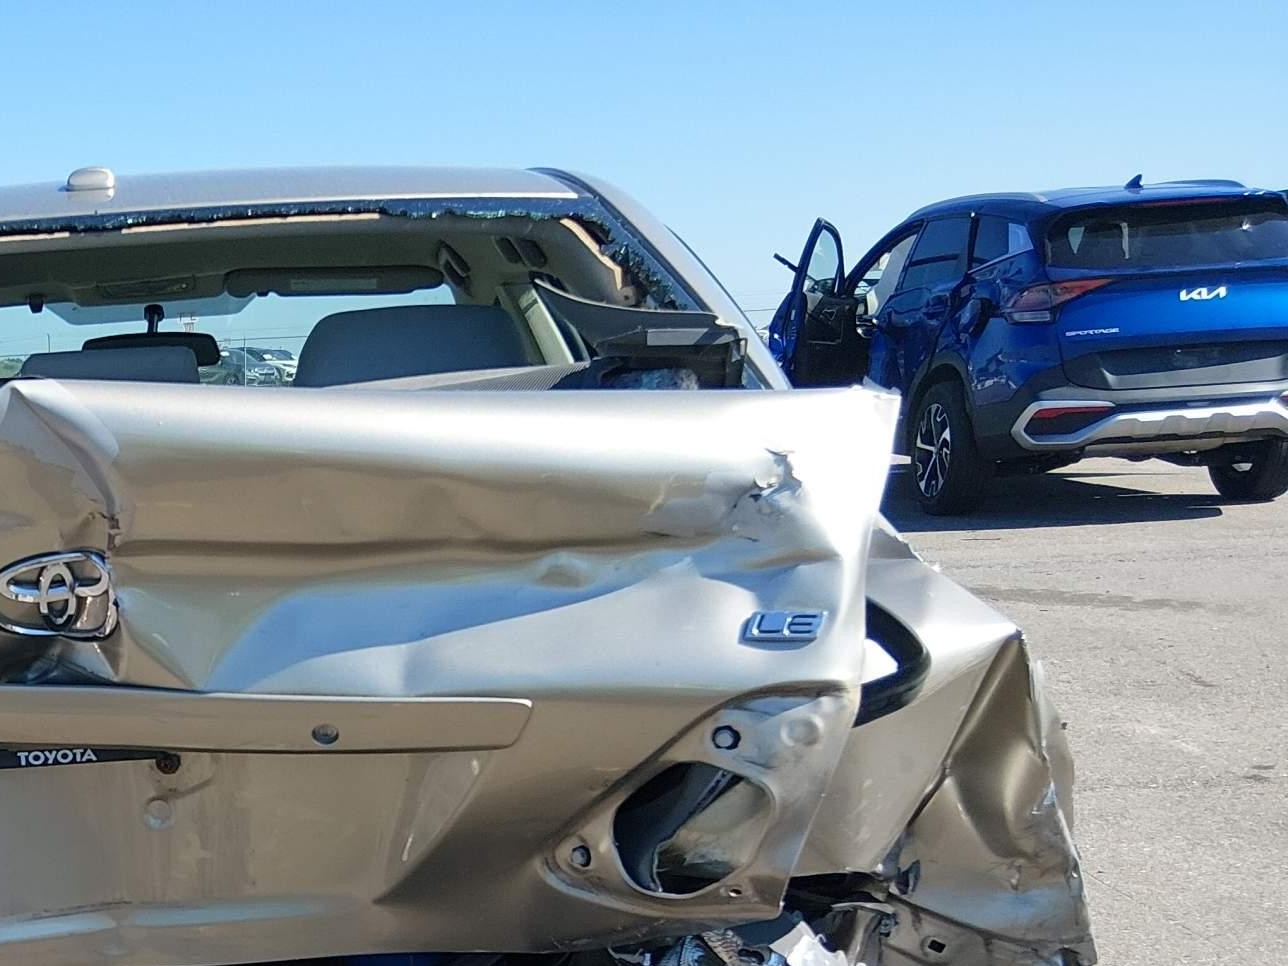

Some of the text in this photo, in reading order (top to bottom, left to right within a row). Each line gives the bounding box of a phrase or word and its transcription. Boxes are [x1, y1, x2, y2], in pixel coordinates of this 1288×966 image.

[1179, 286, 1227, 301] KIA
[1065, 327, 1120, 337] SPORTAGE
[743, 610, 825, 641] LE
[16, 748, 98, 767] TOYOTA
